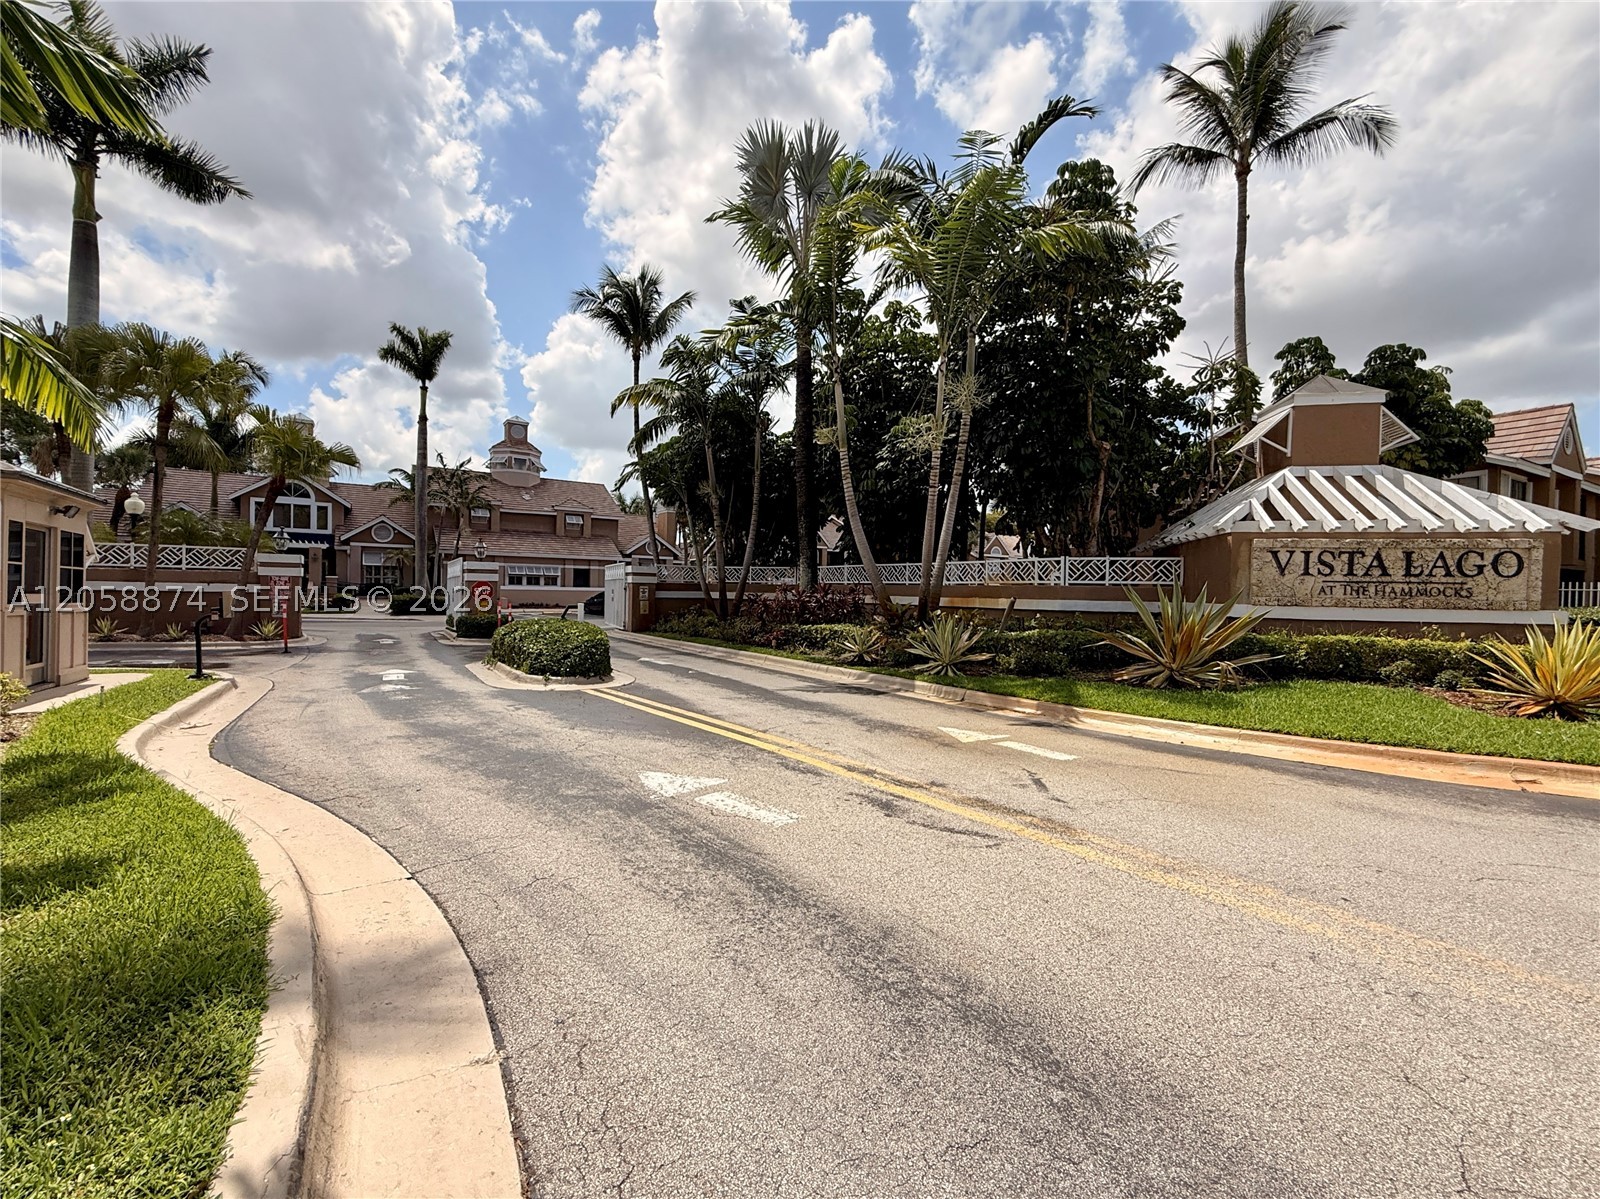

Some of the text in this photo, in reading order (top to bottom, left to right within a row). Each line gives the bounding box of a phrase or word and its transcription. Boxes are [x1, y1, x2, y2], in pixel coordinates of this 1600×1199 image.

[1266, 548, 1525, 578] VISTA LAGO
[1318, 584, 1474, 599] AT THE HAMMOCKS
